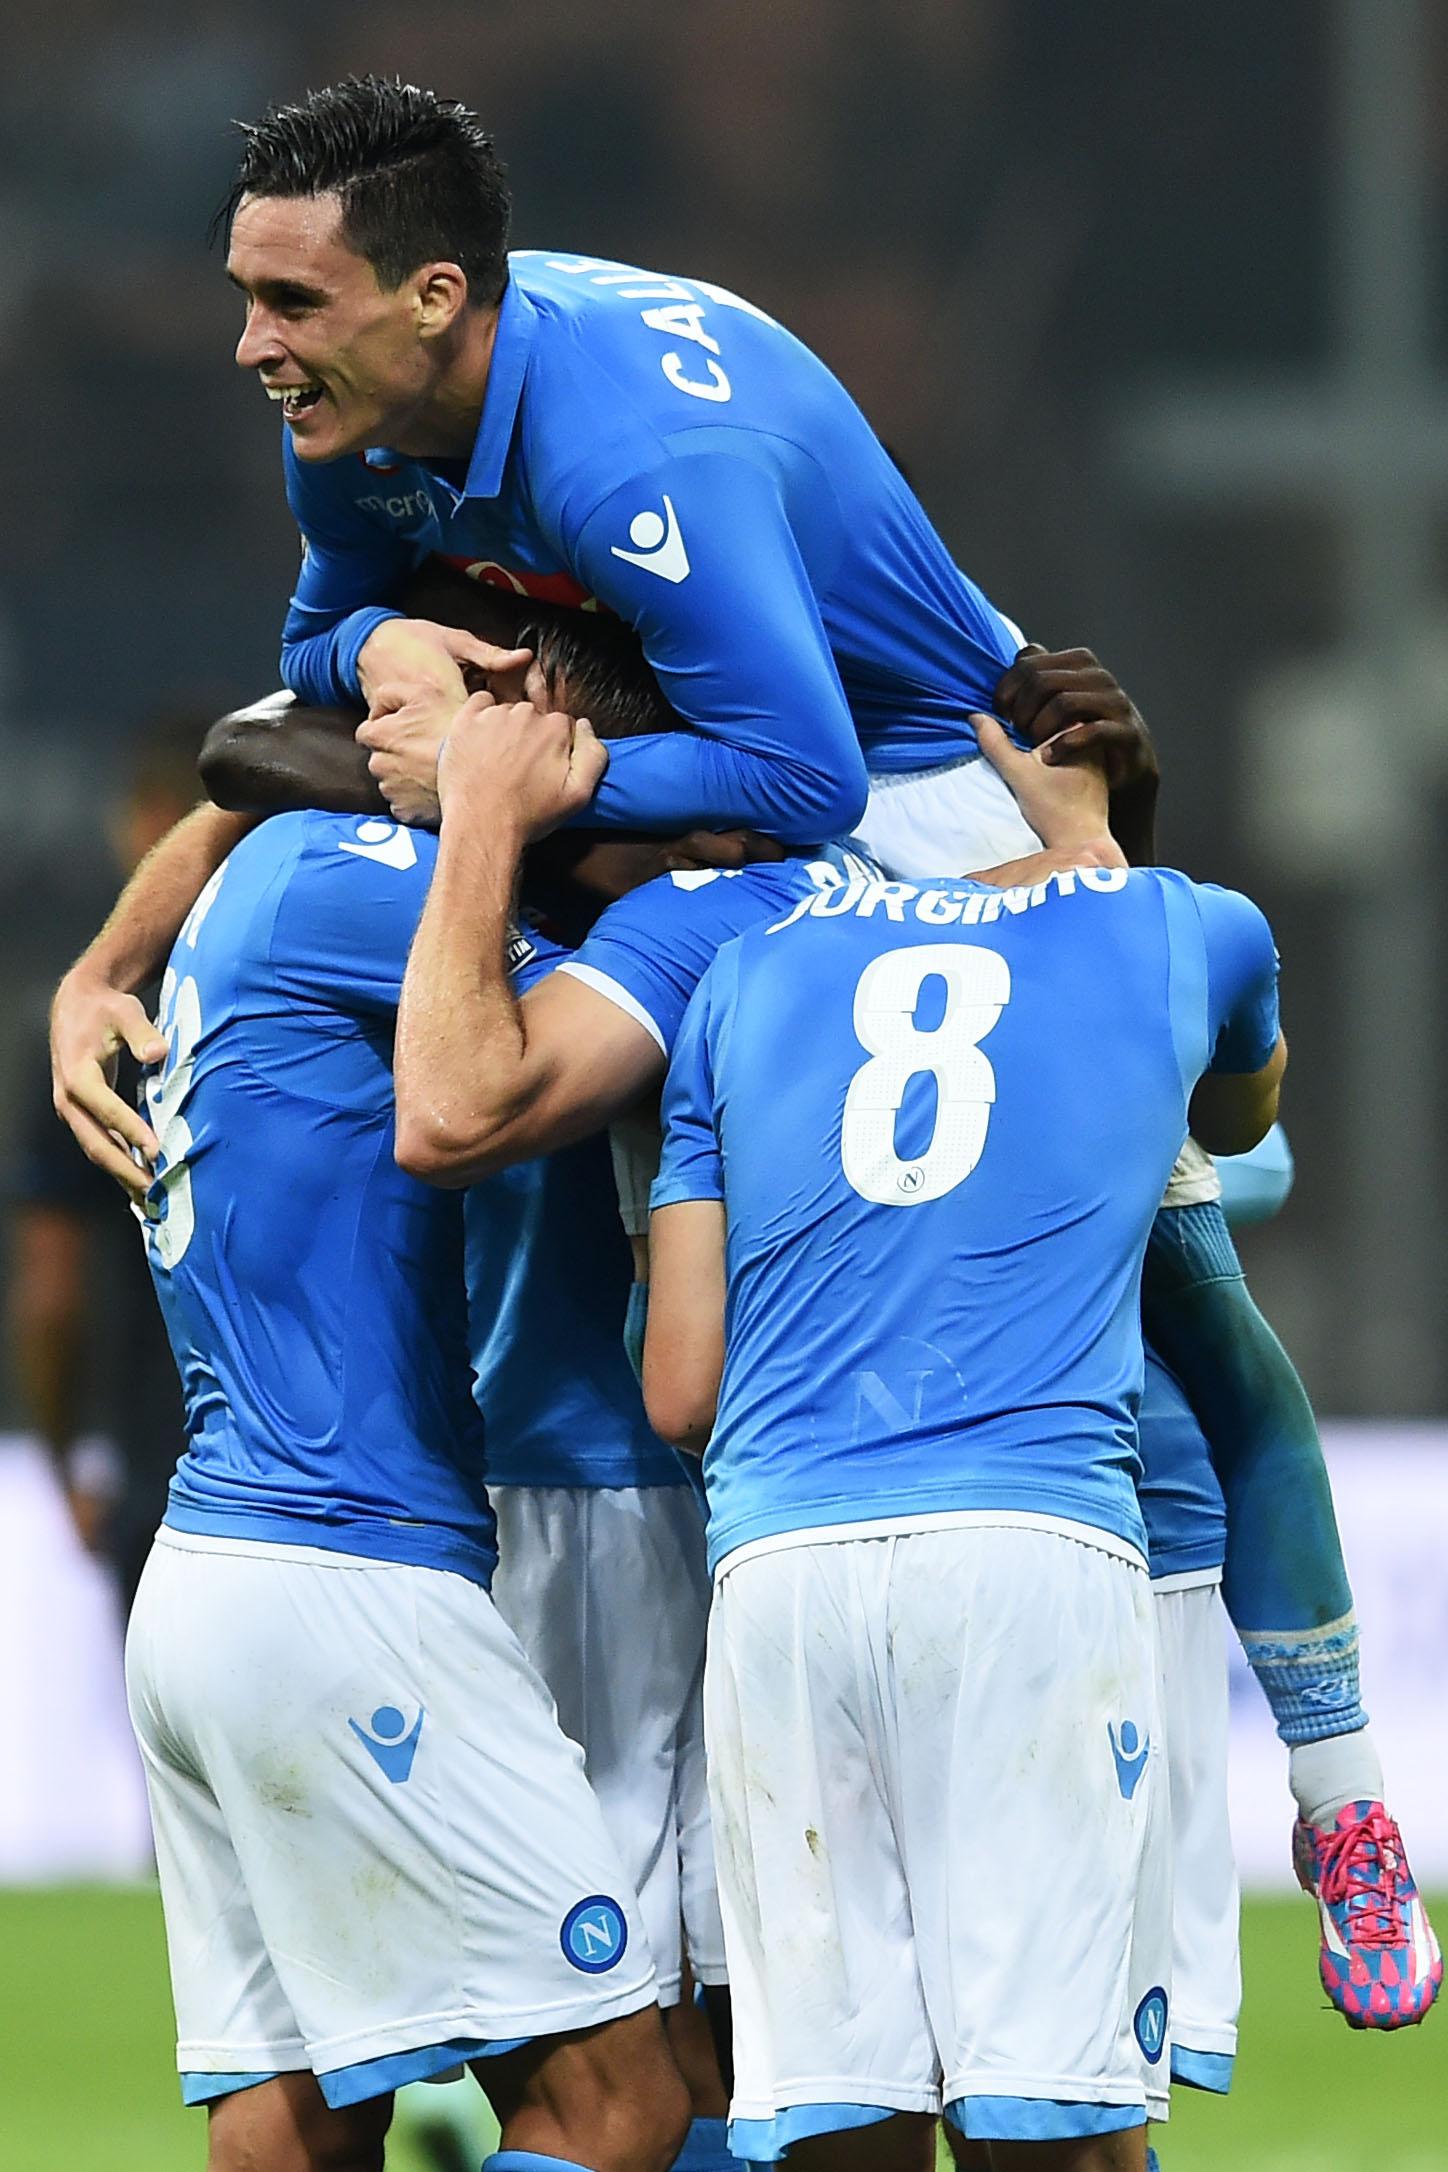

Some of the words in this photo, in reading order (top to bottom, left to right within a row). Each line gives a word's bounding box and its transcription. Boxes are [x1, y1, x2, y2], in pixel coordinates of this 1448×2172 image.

[841, 943, 1011, 1206] 8
[577, 1914, 614, 1957] N
[1143, 2008, 1162, 2043] N
